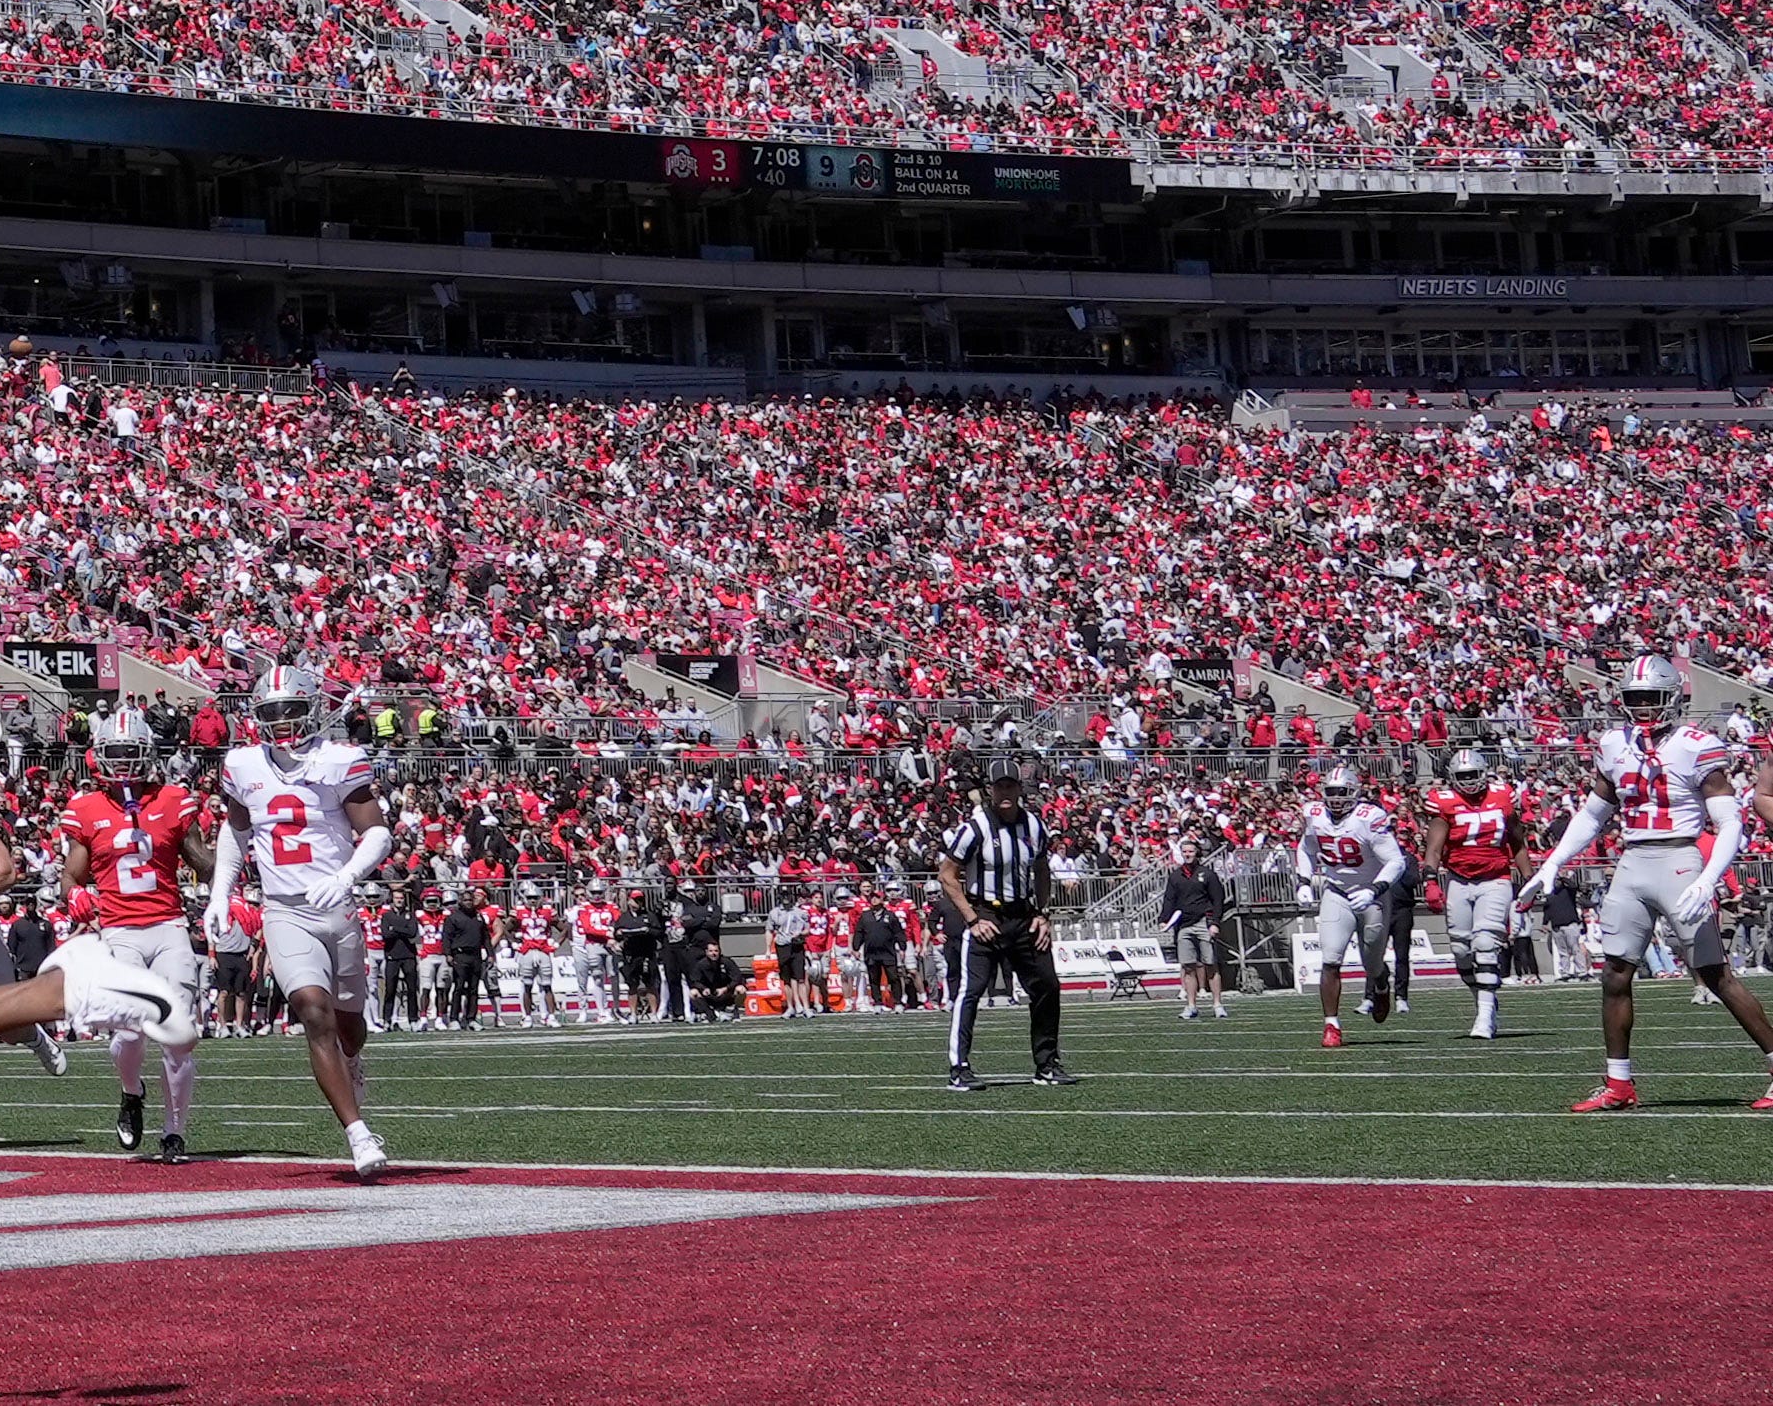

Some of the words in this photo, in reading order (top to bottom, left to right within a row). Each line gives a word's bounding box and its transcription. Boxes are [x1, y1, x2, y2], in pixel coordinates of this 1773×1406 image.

[712, 149, 726, 171] 3
[751, 146, 801, 166] 7:08
[893, 153, 914, 164] 2nd
[916, 155, 924, 165] &
[928, 155, 942, 165] 10
[820, 155, 835, 176] 9
[894, 167, 923, 178] BALL
[925, 169, 942, 179] ON
[945, 170, 959, 180] 14
[896, 182, 916, 193] 2nd
[918, 183, 971, 195] QUARTER
[995, 179, 1061, 191] MORTGAGE
[1402, 279, 1477, 295] NETJETS
[1485, 279, 1567, 296] LANDING
[103, 655, 112, 668] 3
[1178, 667, 1234, 681] CAMBRIA
[1619, 772, 1673, 830] 21
[267, 793, 313, 866] 2
[1454, 808, 1506, 847] 77
[1315, 835, 1364, 868] 58
[112, 828, 158, 894] 2
[747, 998, 759, 1013] G
